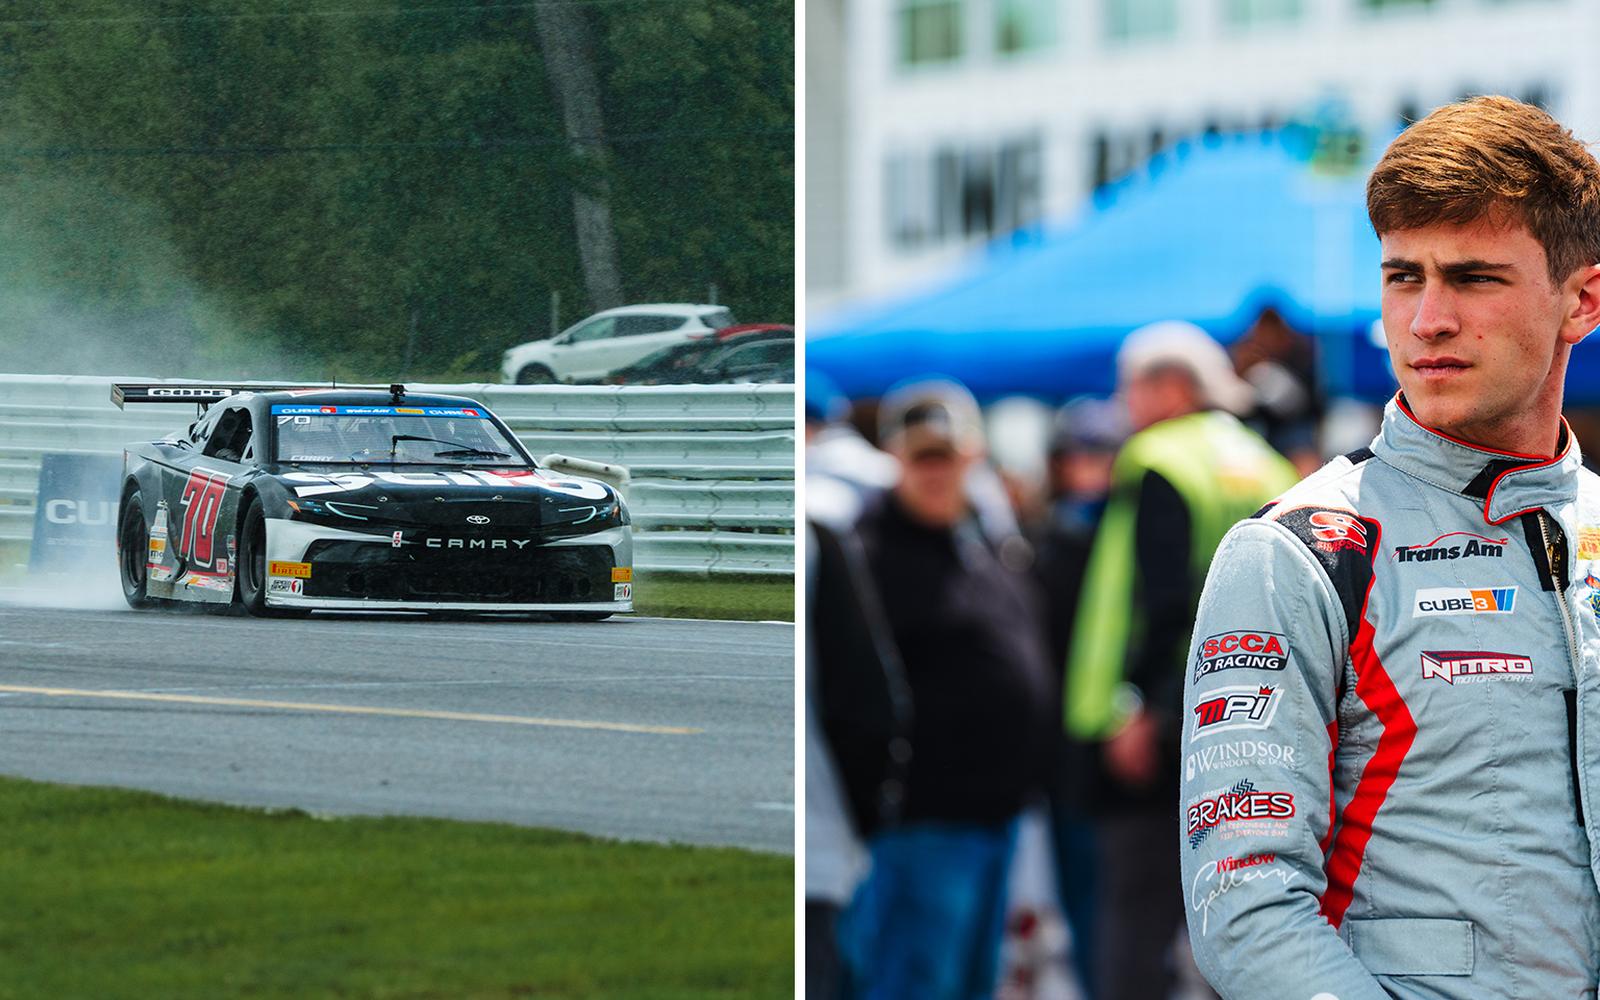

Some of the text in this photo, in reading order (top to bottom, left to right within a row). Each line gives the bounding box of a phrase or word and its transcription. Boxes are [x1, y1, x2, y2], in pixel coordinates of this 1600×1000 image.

[278, 416, 311, 425] 70
[180, 467, 233, 568] 70
[426, 538, 531, 549] CAMRY
[1396, 539, 1503, 563] Trans Am
[1419, 598, 1489, 612] CUBE3
[1204, 634, 1285, 658] SCCA
[1214, 655, 1280, 671] RACING
[1421, 654, 1533, 685] NITRO
[1453, 674, 1534, 685] MOTORSPORTS
[1197, 740, 1295, 773] WINDSOR
[1188, 793, 1295, 833] BRAKES
[1217, 853, 1276, 873] Window
